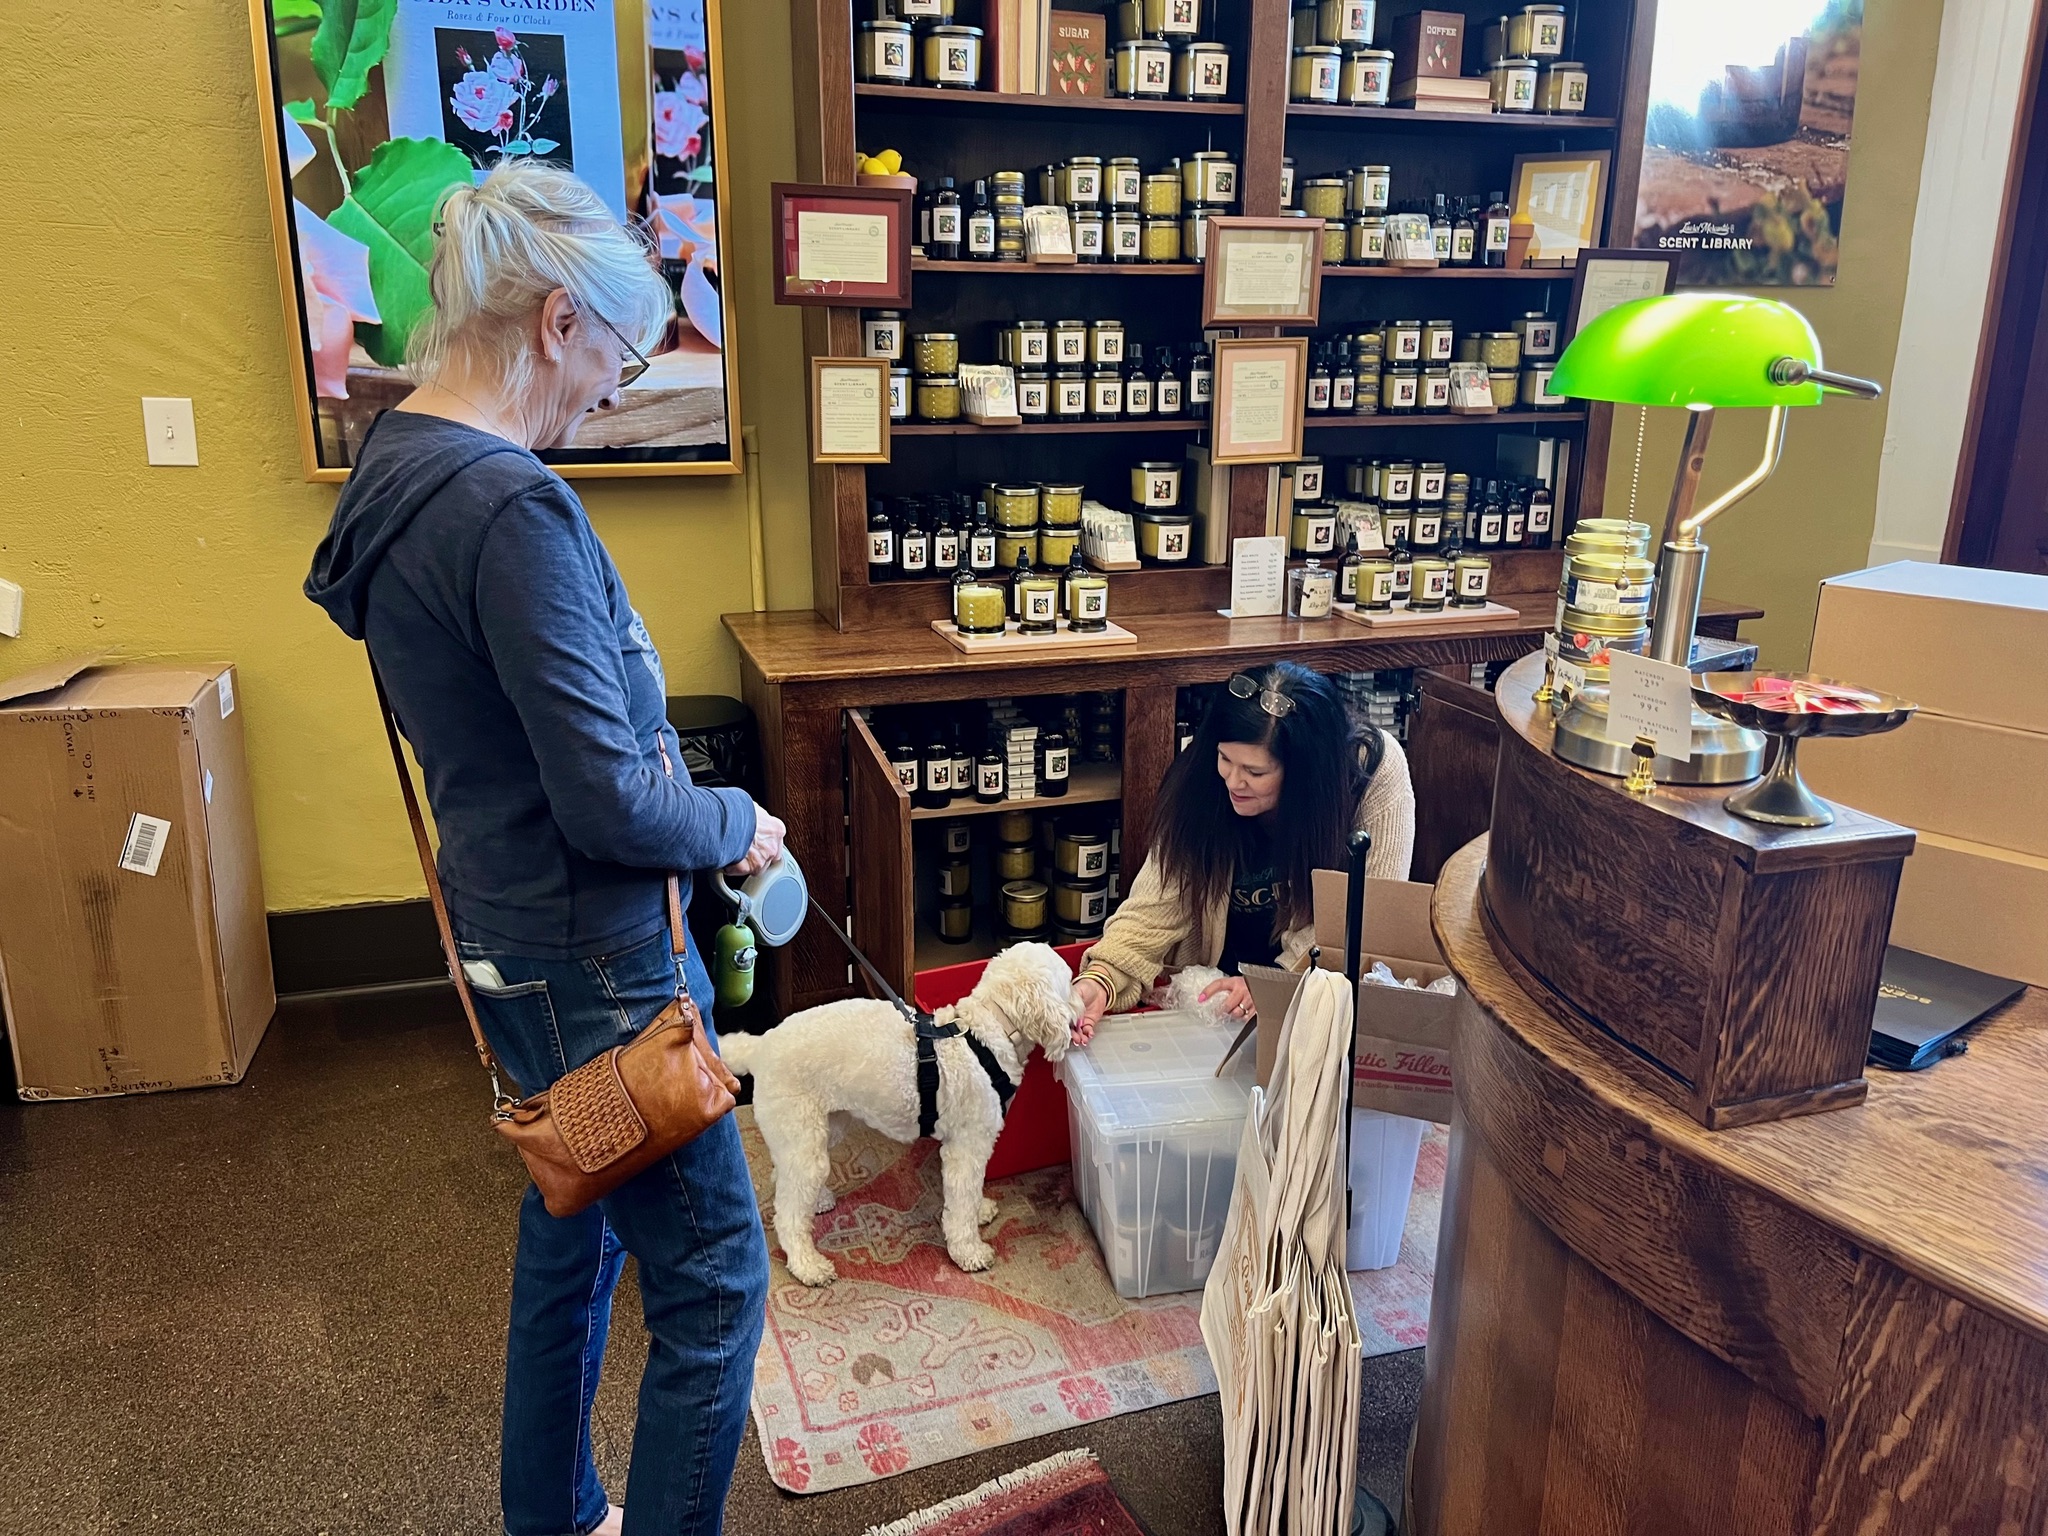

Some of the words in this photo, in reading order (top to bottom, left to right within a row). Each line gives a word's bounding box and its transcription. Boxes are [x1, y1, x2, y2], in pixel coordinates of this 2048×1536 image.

[500, 0, 596, 12] GARDEN
[447, 10, 472, 20] Roses
[476, 12, 483, 21] &
[487, 13, 510, 23] Four
[1058, 26, 1090, 39] SUGAR
[1426, 25, 1457, 36] COFFEE
[1658, 236, 1699, 249] SCENT
[1701, 237, 1753, 250] LIBRARY
[1634, 669, 1665, 681] MATCHBOX
[1632, 692, 1667, 706] MATCHBOOK
[1647, 721, 1678, 734] MATCHBOX
[1354, 1053, 1387, 1069] atic
